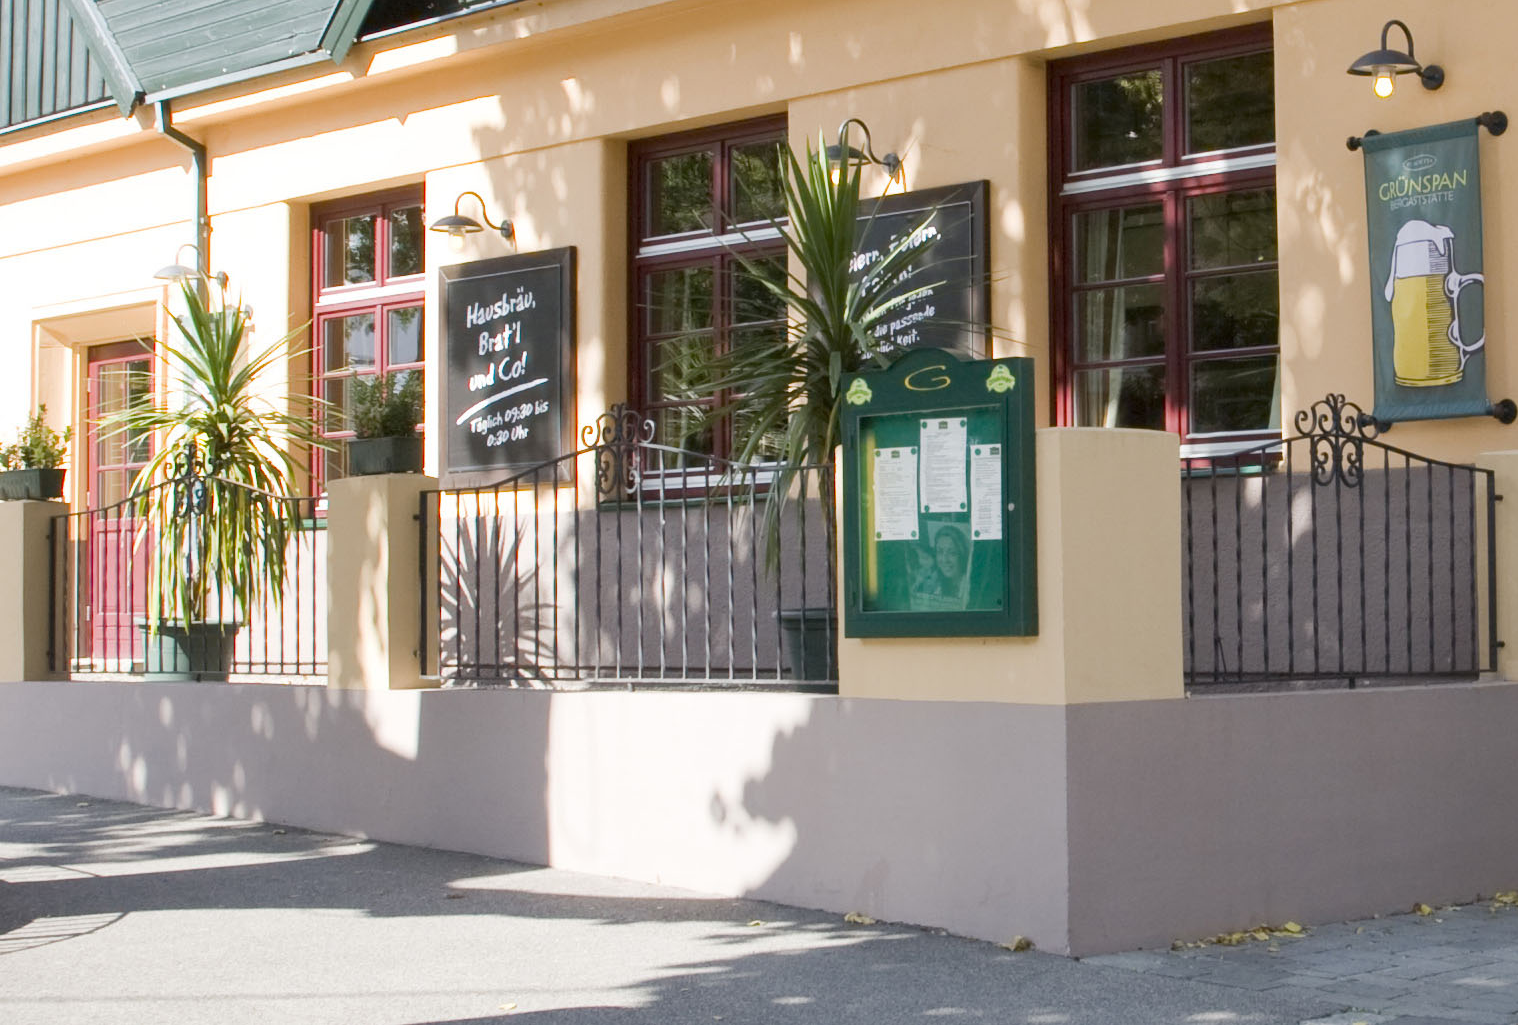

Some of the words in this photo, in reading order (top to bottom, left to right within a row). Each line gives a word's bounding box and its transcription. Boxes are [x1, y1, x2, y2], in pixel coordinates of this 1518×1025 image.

[1379, 169, 1467, 202] GRÜNSPAN
[466, 285, 537, 329] Hausbräu,
[468, 362, 495, 392] und
[498, 350, 528, 381] Co!
[904, 365, 951, 392] G
[504, 402, 534, 424] 09:30
[534, 399, 550, 416] bis
[486, 429, 510, 448] 0:30
[510, 424, 530, 442] Uhr
